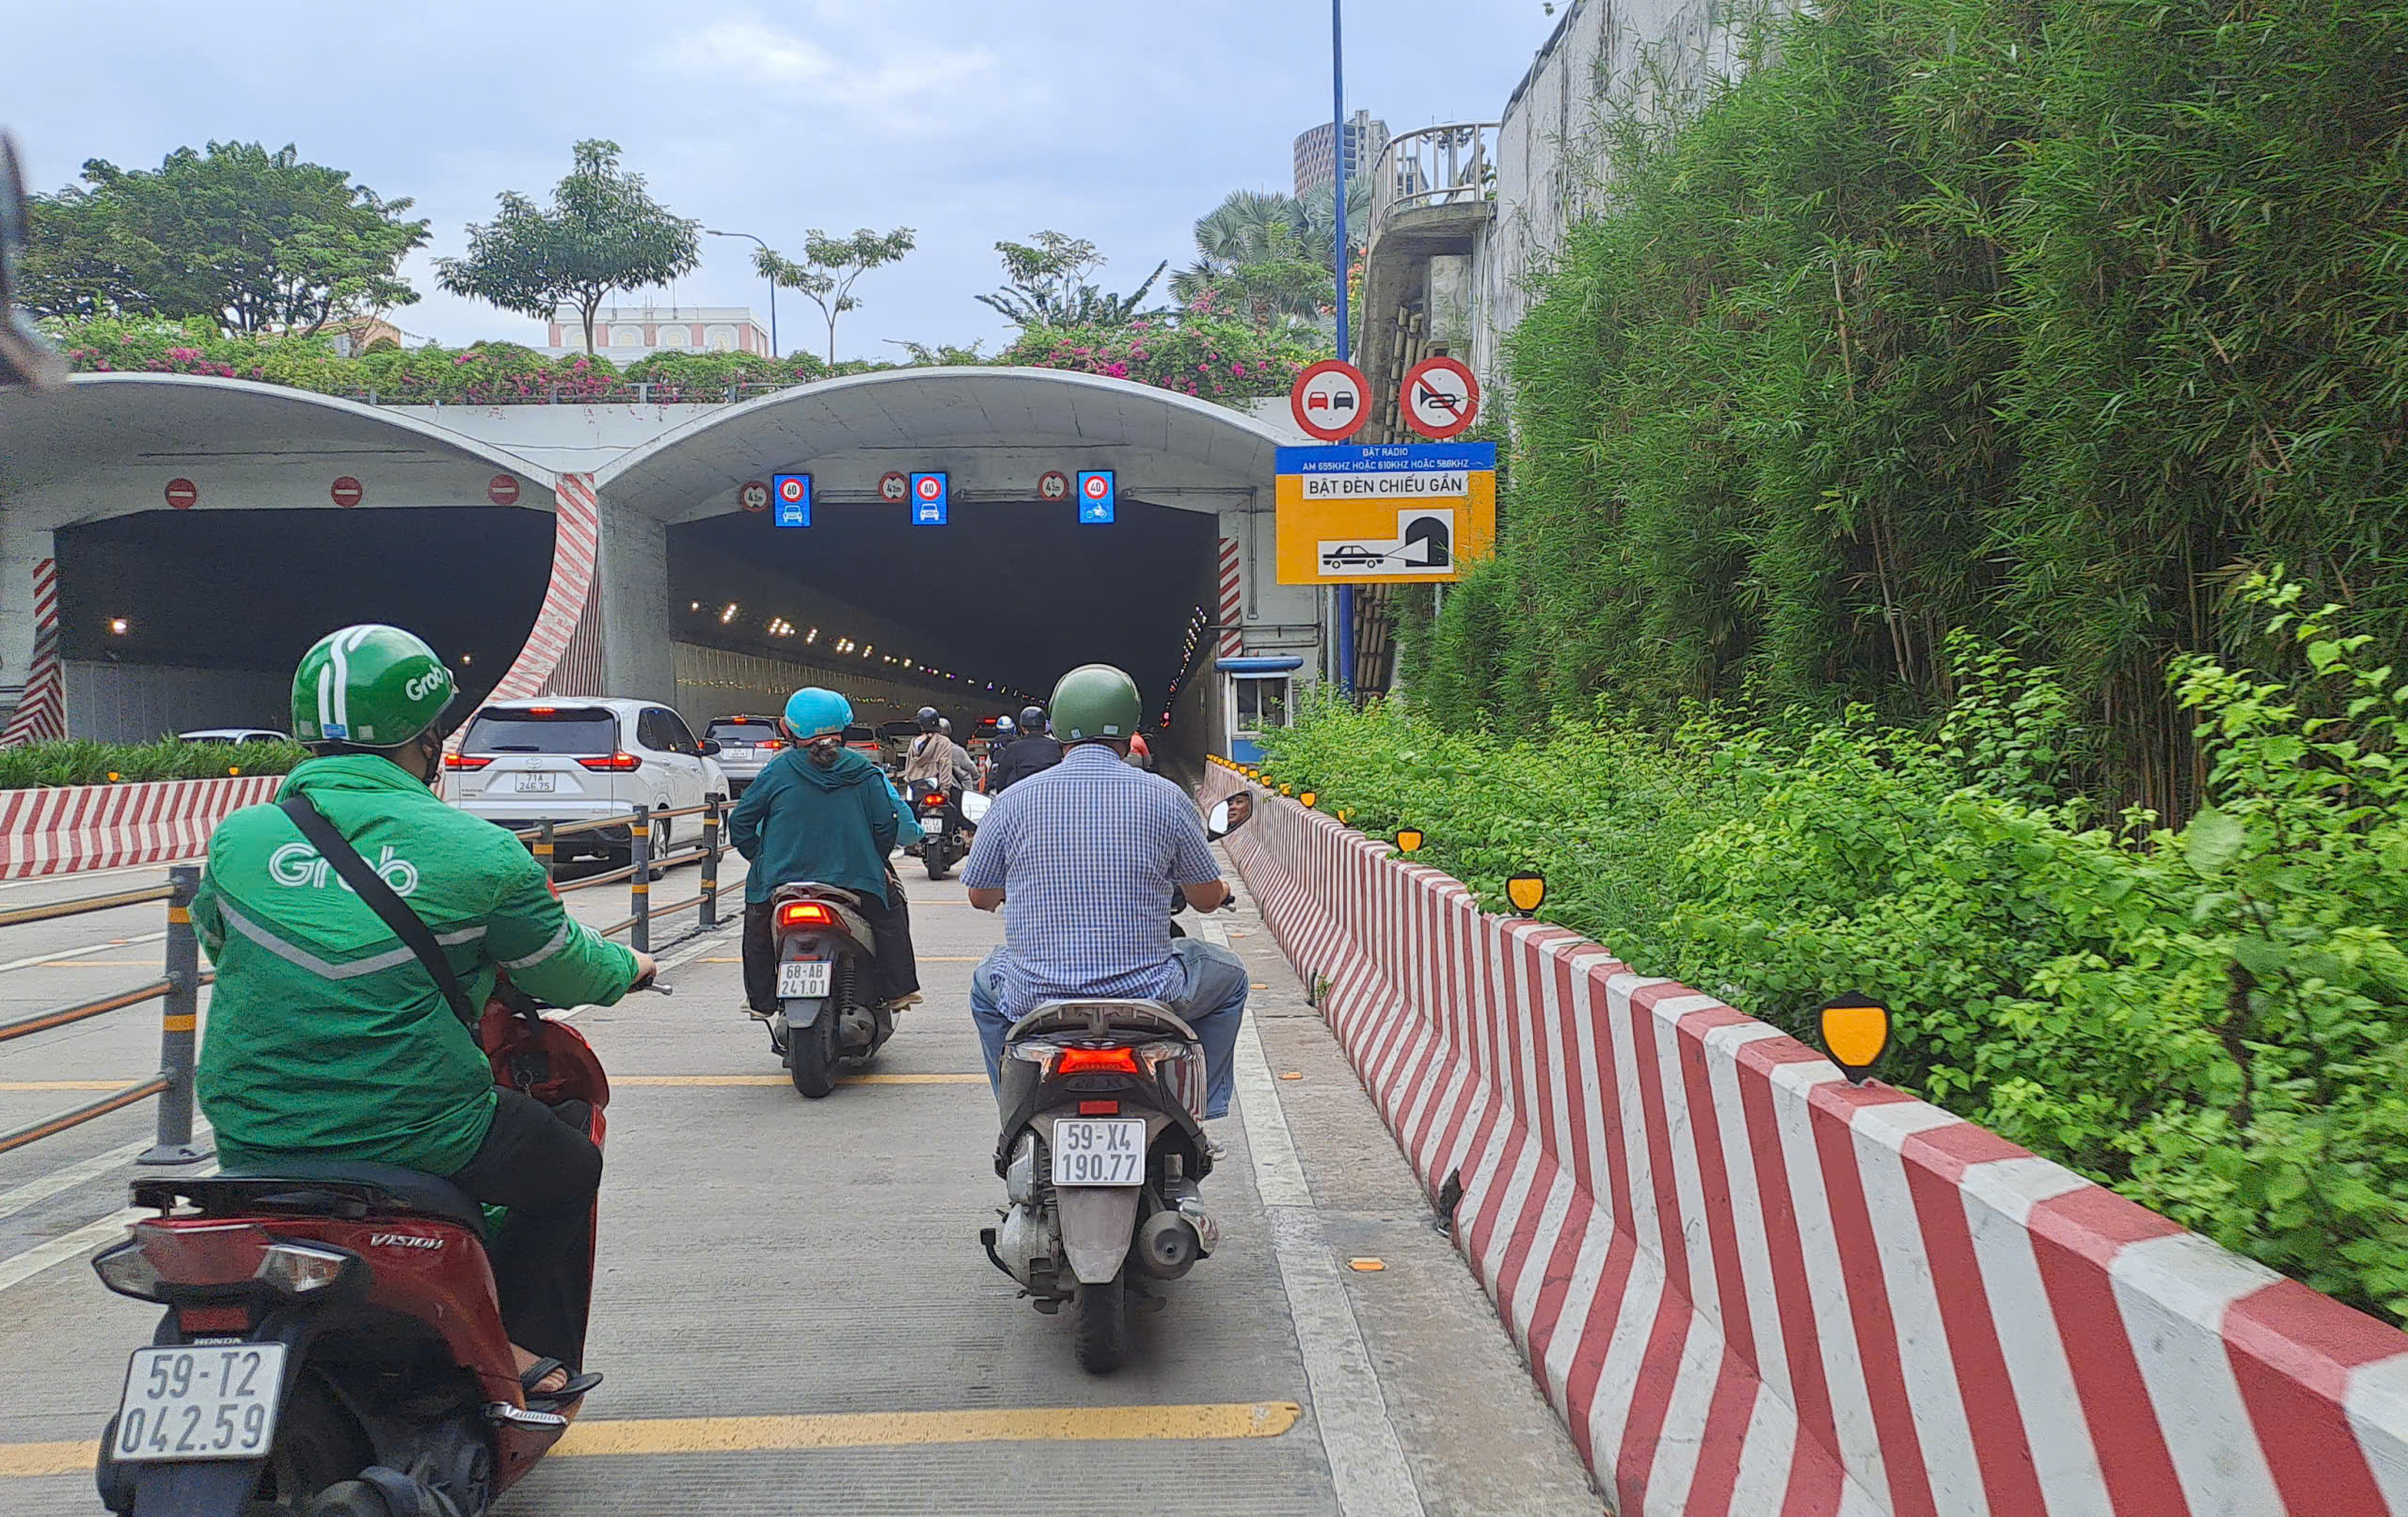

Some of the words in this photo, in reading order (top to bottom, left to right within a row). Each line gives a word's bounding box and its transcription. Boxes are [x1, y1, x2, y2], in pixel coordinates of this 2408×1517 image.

[1362, 447, 1379, 459] BẬT
[1382, 447, 1408, 457] RADIO
[1303, 462, 1317, 471] AM
[1352, 460, 1377, 471] HOẶC
[1378, 460, 1409, 470] 610KHZ
[1411, 458, 1435, 470] HOẶC
[786, 484, 798, 496] 60
[924, 483, 934, 494] 60
[1090, 482, 1101, 493] 40
[1309, 478, 1339, 498] BẬT
[1343, 477, 1374, 494] ĐÈN
[1379, 473, 1424, 493] CHIẾU
[1430, 473, 1462, 491] GẦN
[405, 663, 444, 702] Grab
[526, 773, 544, 782] 71A
[519, 782, 550, 792] 246.75
[268, 843, 419, 897] Grb
[786, 964, 823, 979] 68-AB
[782, 980, 825, 995] 241.01
[1068, 1124, 1132, 1151] 59-X4
[1062, 1153, 1137, 1181] 190.77
[369, 1232, 444, 1250] VISION
[194, 1337, 242, 1346] HONDA
[147, 1351, 261, 1399] 59-T2
[121, 1403, 265, 1453] 042.59
